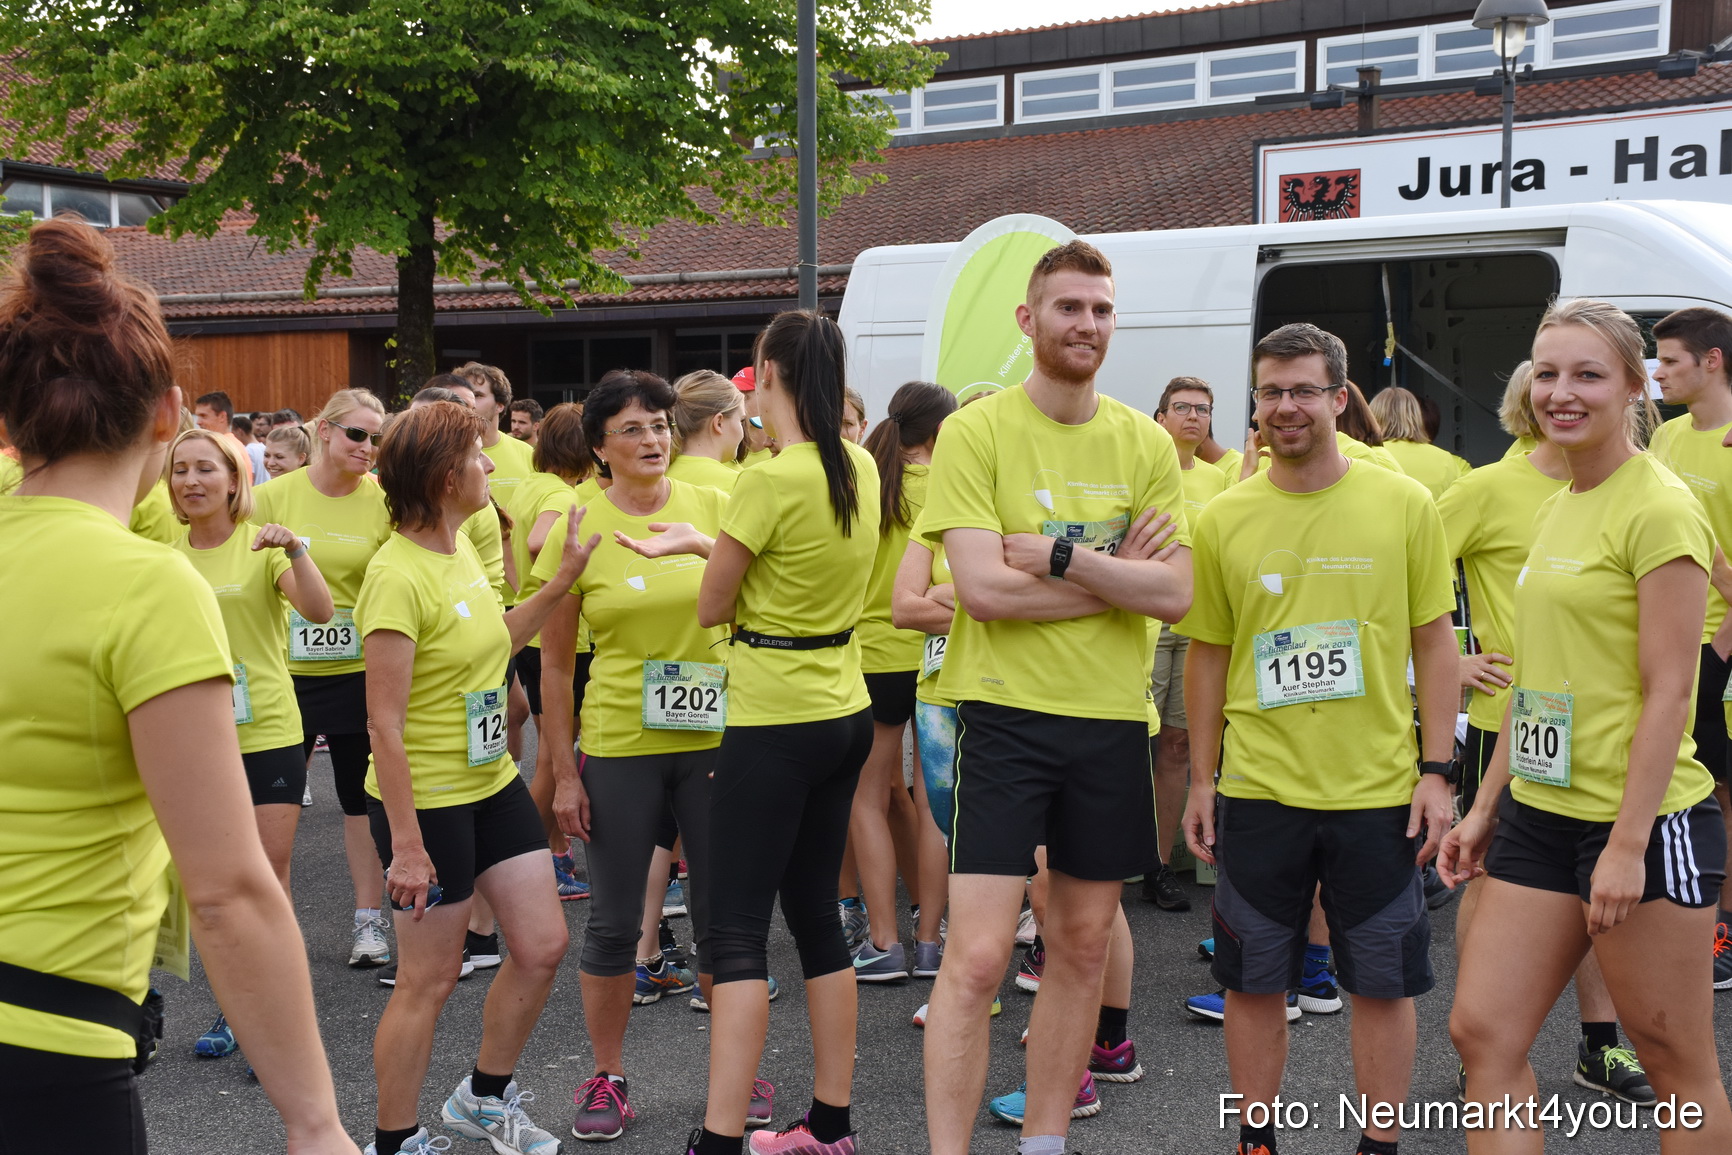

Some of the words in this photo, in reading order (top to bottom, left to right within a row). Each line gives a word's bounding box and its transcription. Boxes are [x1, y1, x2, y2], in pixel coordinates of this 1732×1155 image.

[1398, 156, 1546, 201] Jura
[1570, 165, 1588, 176] -
[999, 345, 1025, 377] Kliniken
[299, 627, 351, 646] 1203
[758, 638, 793, 647] EDLENSER
[928, 636, 947, 659] 12
[1268, 640, 1307, 653] firmenlauf
[1332, 641, 1352, 649] 2019
[1268, 649, 1347, 685] 1195
[1282, 684, 1300, 692] Auer
[1302, 679, 1336, 690] Stephan
[655, 685, 718, 712] 1202
[1283, 690, 1307, 698] Klinikum
[1308, 687, 1335, 695] Neumarkt
[688, 711, 709, 719] Goretti
[1549, 718, 1566, 726] 2019
[483, 741, 500, 750] Kratzer
[1514, 720, 1559, 759] 1210
[1538, 758, 1552, 768] Alisa
